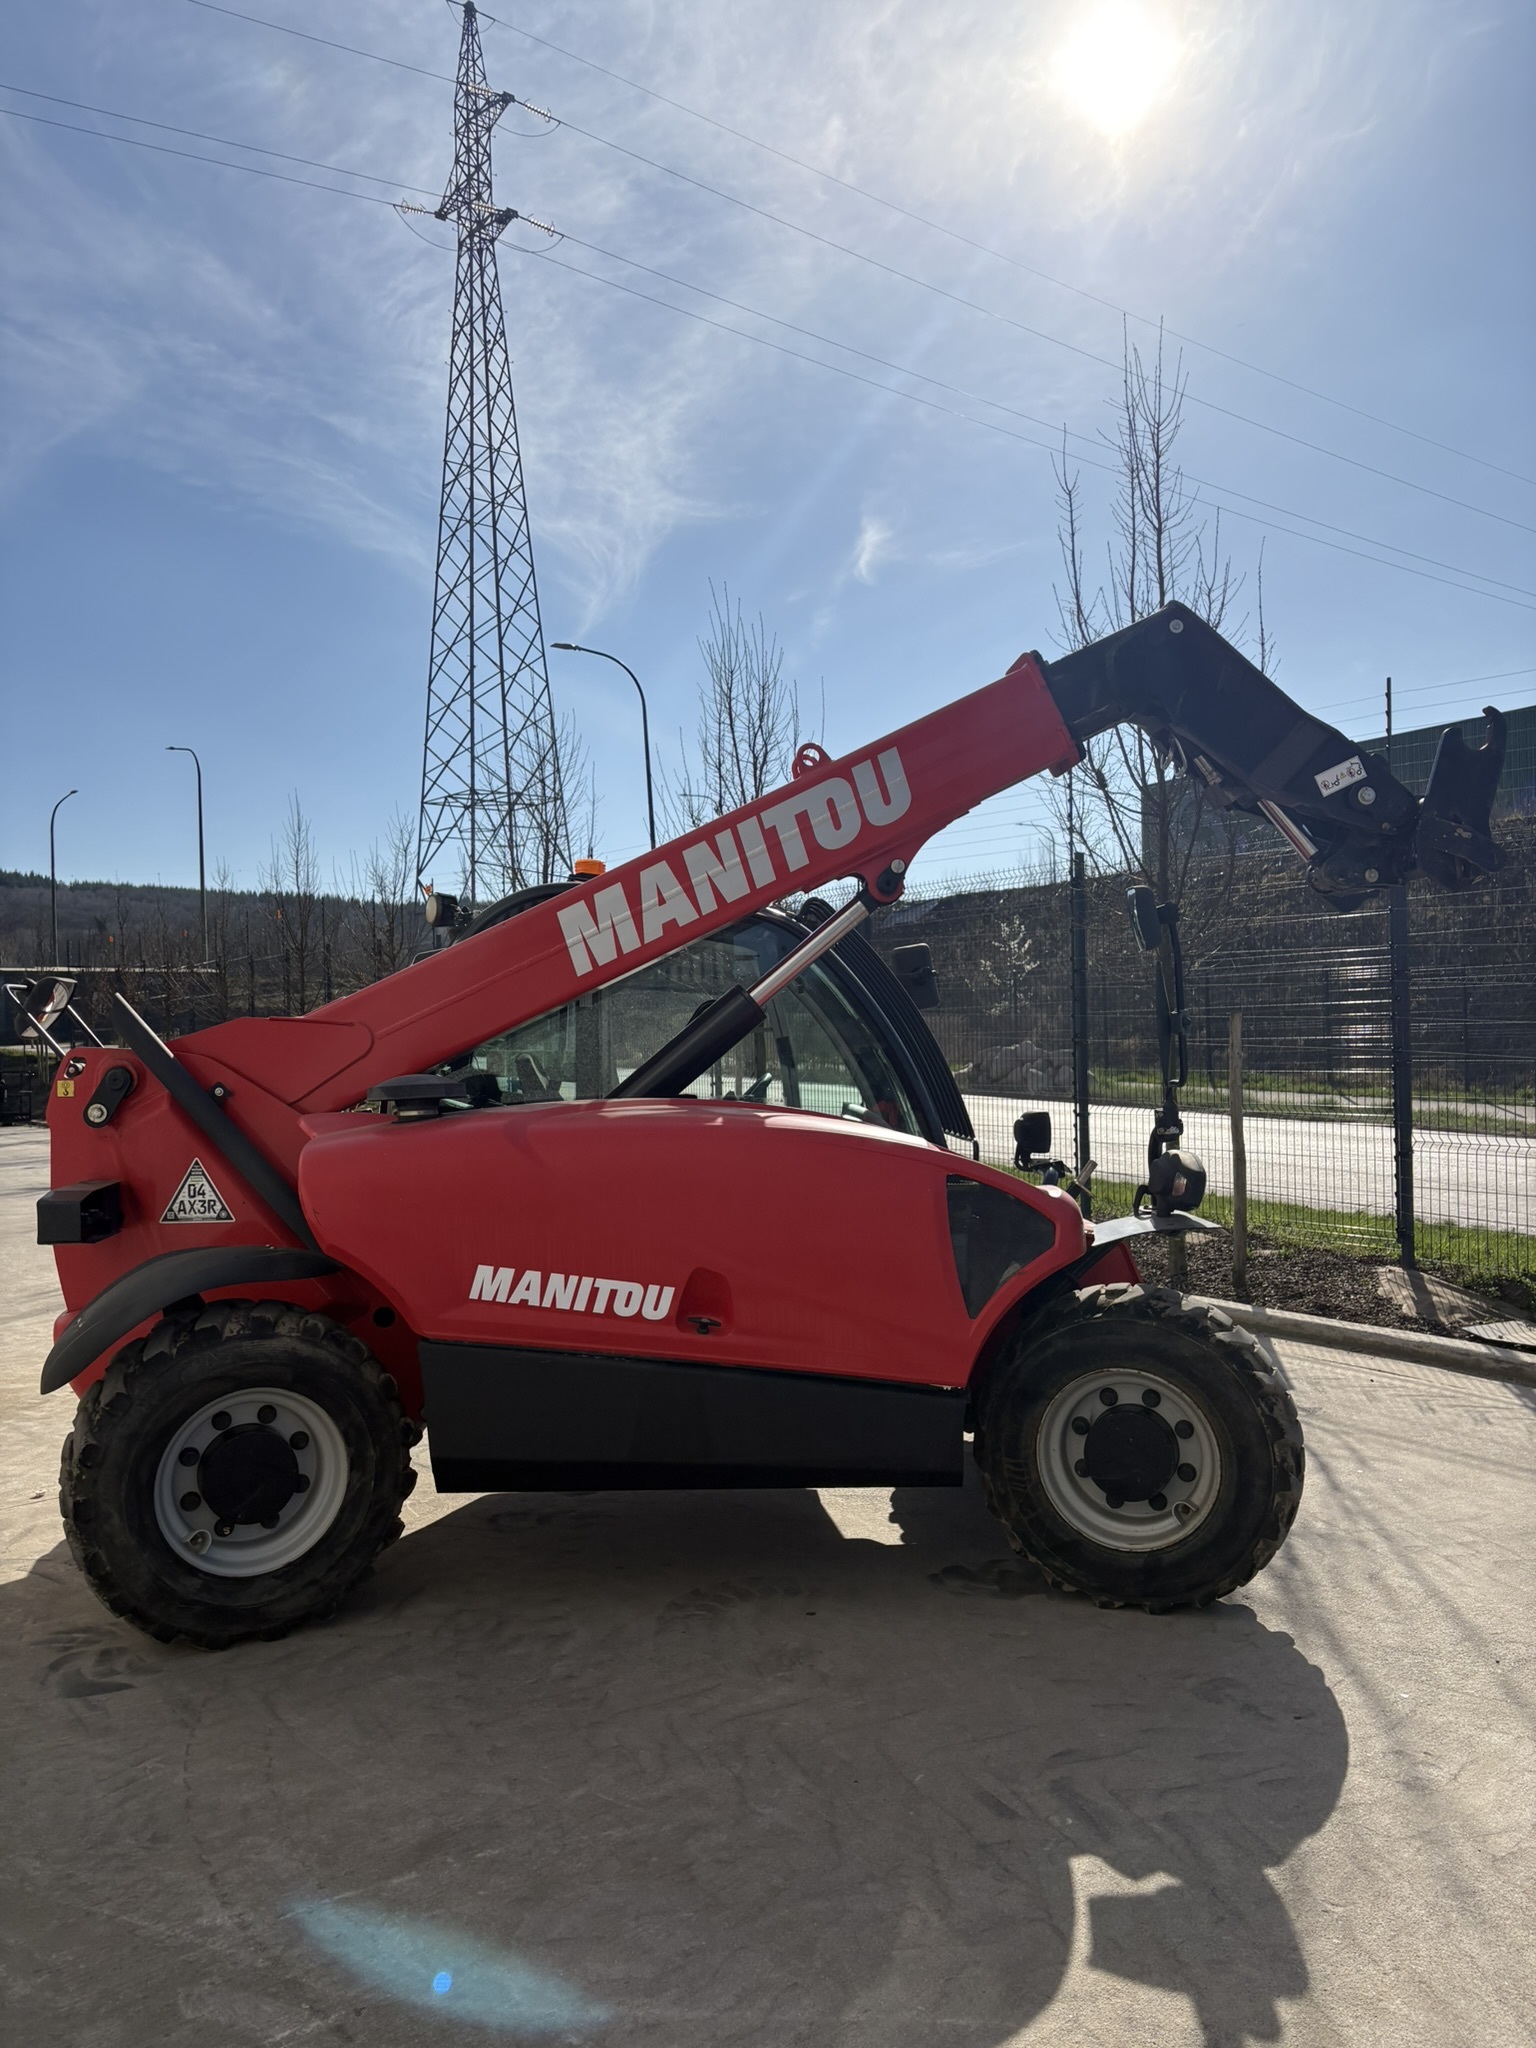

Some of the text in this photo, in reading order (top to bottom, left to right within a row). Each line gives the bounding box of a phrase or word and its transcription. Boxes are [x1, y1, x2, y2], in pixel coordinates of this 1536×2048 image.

[556, 746, 912, 977] MANITOU
[177, 1199, 217, 1215] AX3R
[468, 1264, 676, 1321] MANITOU
